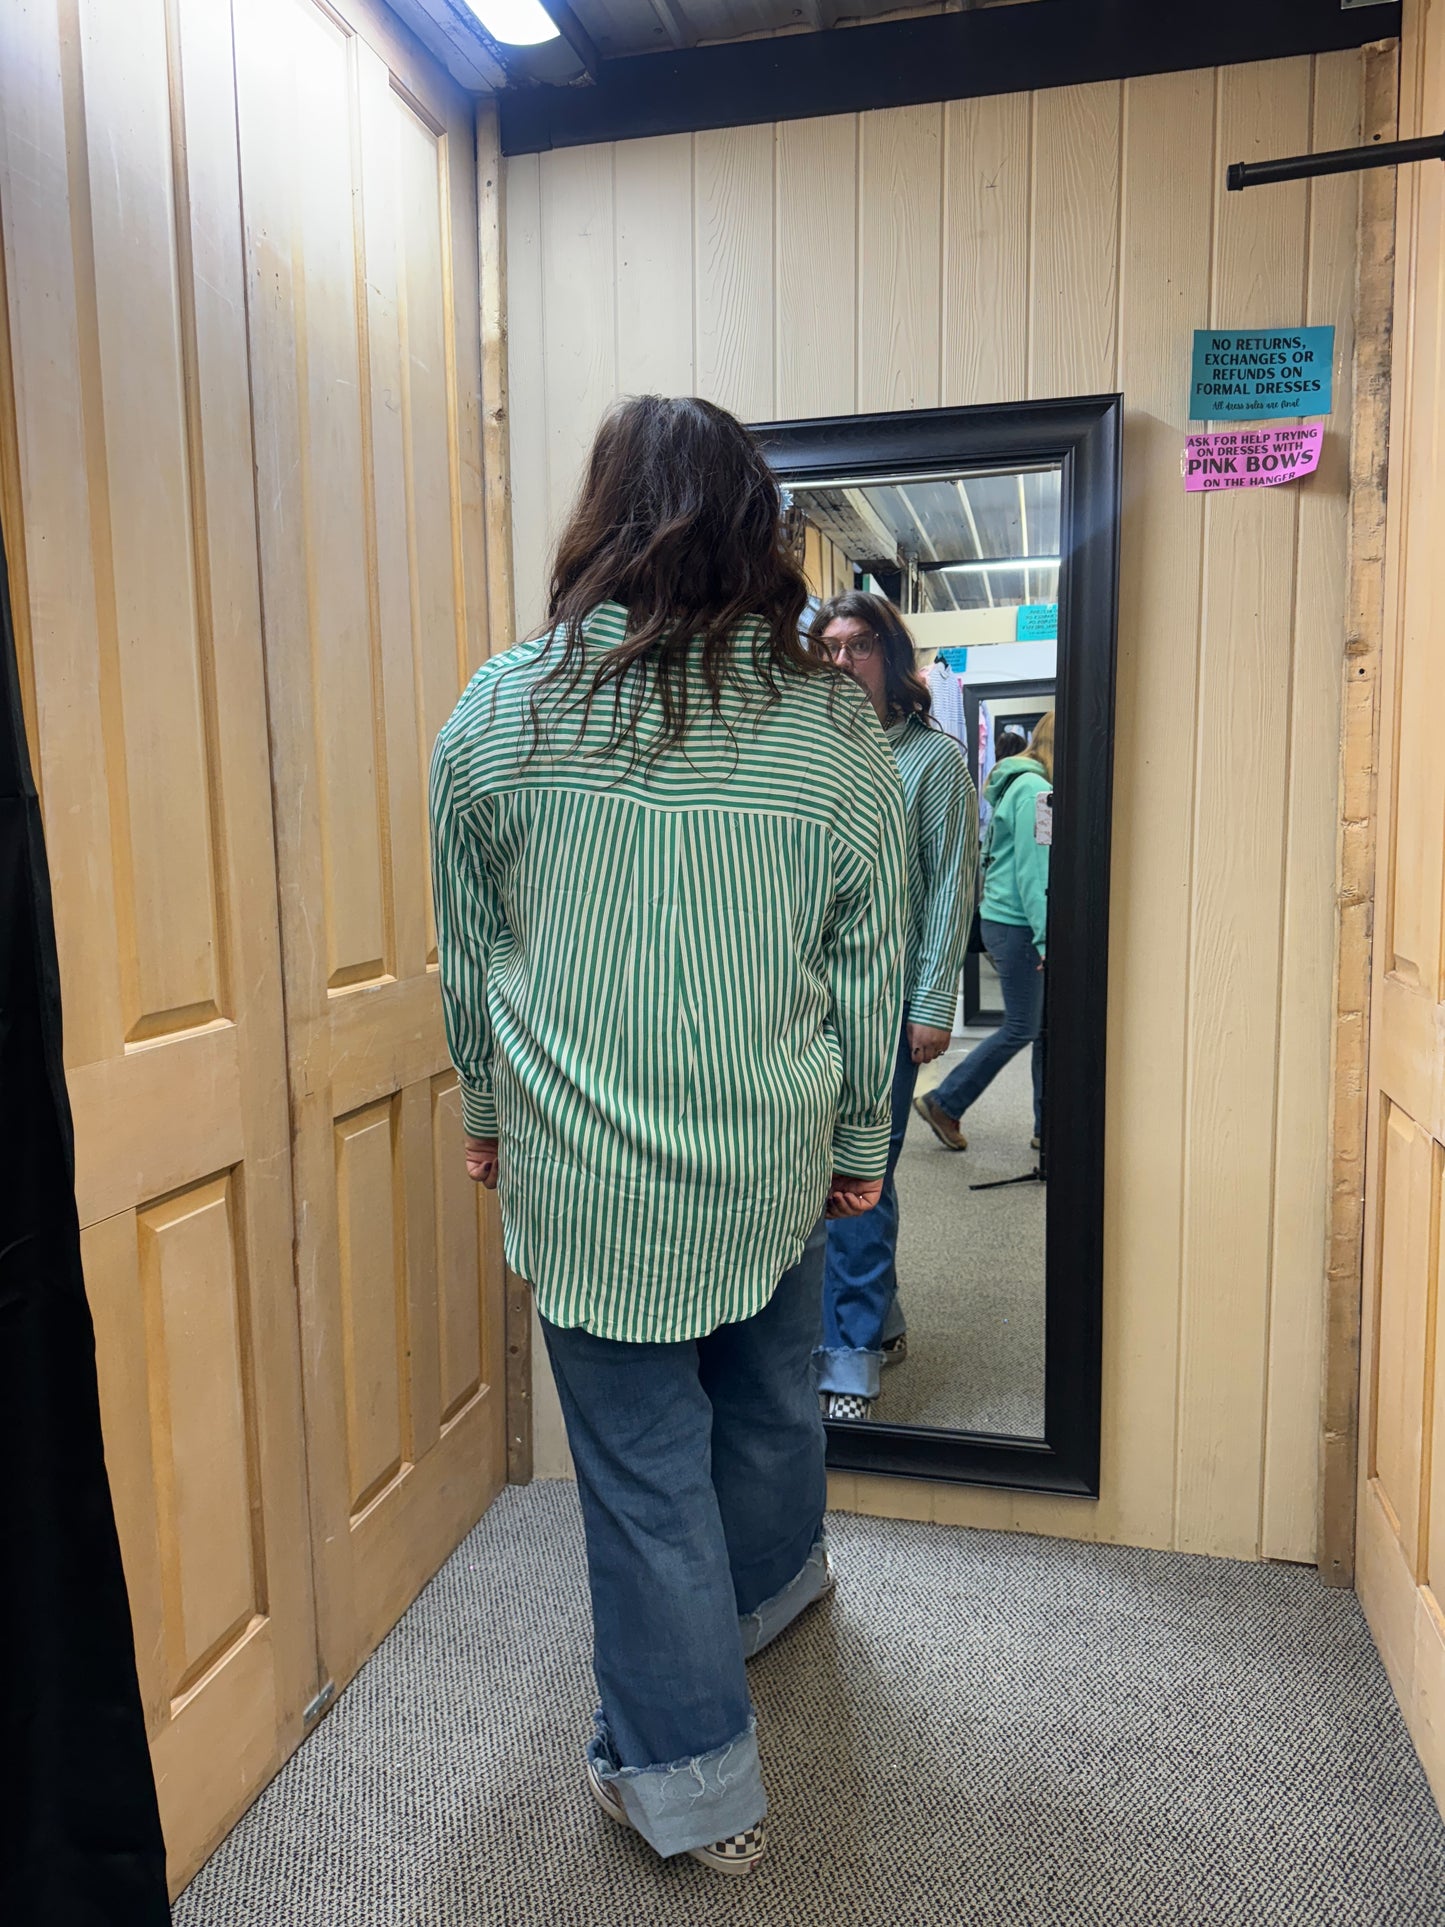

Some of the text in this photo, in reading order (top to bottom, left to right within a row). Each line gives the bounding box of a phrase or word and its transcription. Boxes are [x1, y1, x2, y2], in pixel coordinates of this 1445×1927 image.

[1212, 337, 1306, 350] NO RETURNS,
[1205, 351, 1314, 365] EXCHANGES OR
[1213, 367, 1302, 380] REFUNDS ON
[1196, 380, 1321, 395] FORMAL DRESSES
[1225, 401, 1244, 410] dress
[1246, 400, 1263, 410] sales
[1281, 399, 1300, 408] final
[1188, 429, 1317, 447] ASK FOR HELP TRYING
[1197, 442, 1303, 457] ON DRESSES WITH
[1188, 450, 1313, 475] PINK BOWS
[1203, 472, 1295, 487] ON THE HANGER
